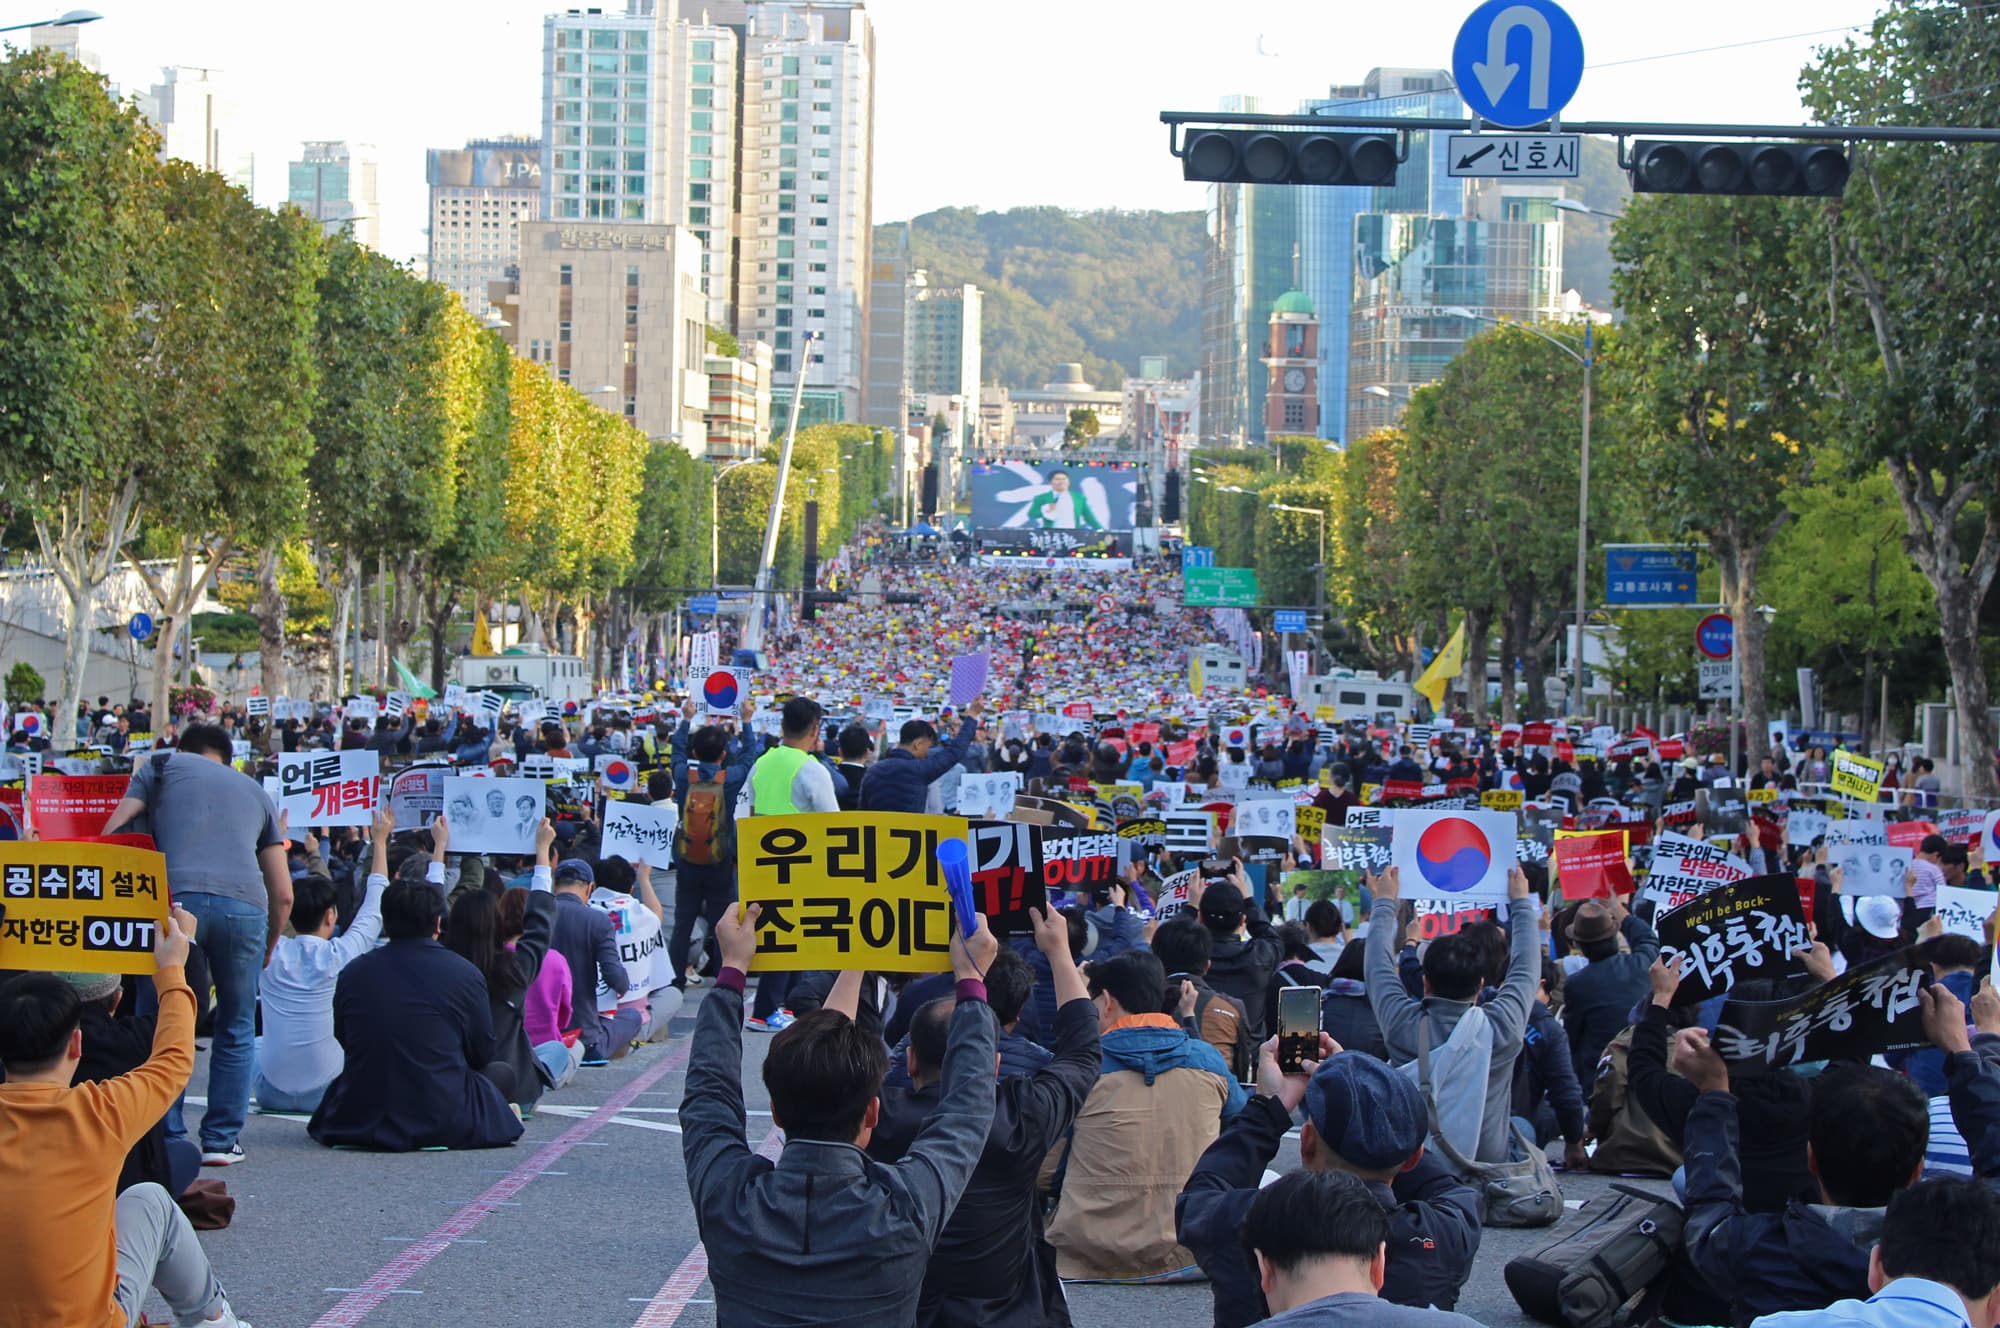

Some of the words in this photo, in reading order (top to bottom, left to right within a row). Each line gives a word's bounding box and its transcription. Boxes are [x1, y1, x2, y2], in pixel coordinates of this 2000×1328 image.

[1498, 141, 1574, 172] 신호시
[1207, 674, 1236, 683] POLICE
[282, 755, 342, 797] 언론
[311, 775, 381, 819] 개혁!
[606, 815, 673, 851] 검찰개혁!
[110, 871, 158, 900] 설치
[1044, 856, 1112, 885] OUT!
[1685, 907, 1714, 929] We'll
[1716, 903, 1731, 918] be
[3, 918, 81, 947] 자한당
[88, 920, 155, 948] OUT
